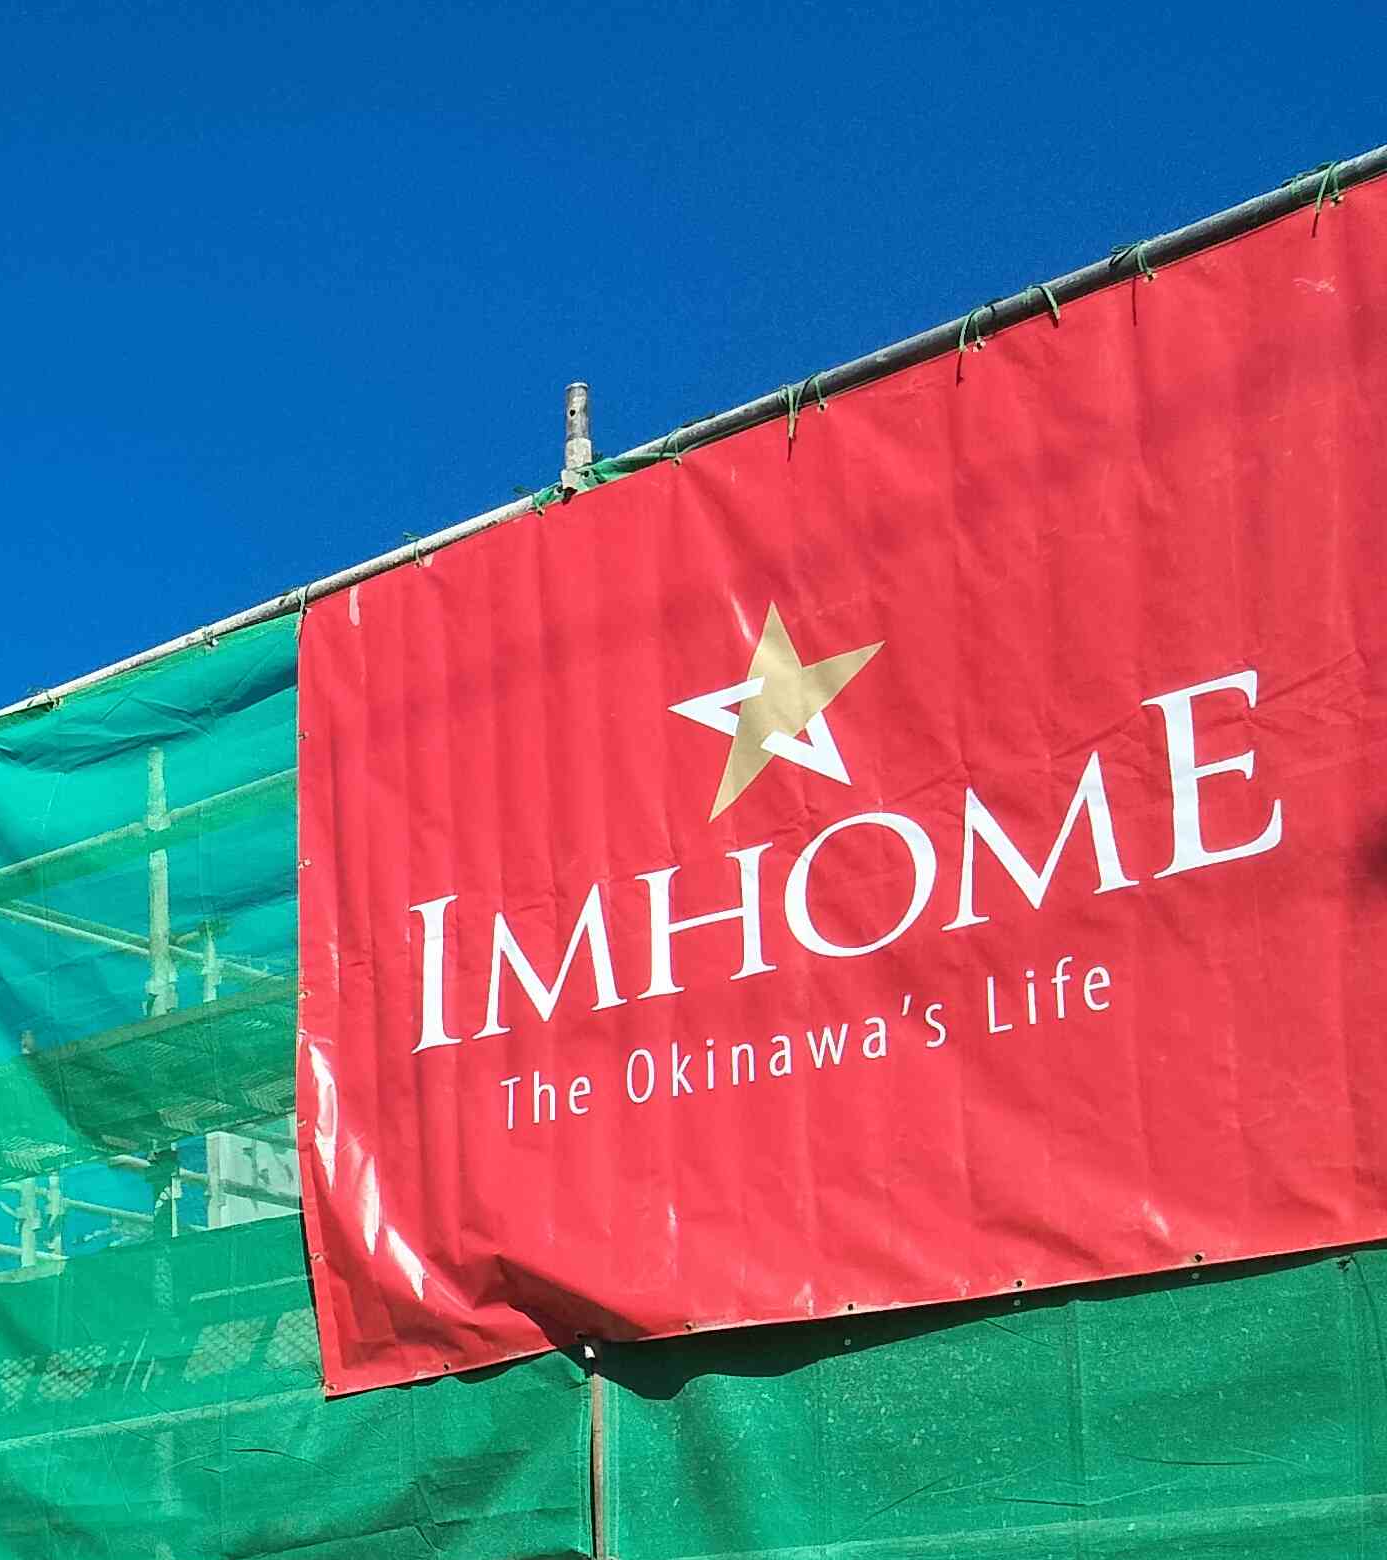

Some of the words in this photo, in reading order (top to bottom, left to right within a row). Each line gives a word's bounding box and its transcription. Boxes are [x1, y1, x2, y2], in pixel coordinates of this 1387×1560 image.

[409, 669, 1284, 1055] IMHOME
[500, 1070, 592, 1130] The
[626, 998, 948, 1104] Okinawa's
[987, 956, 1113, 1035] Life
